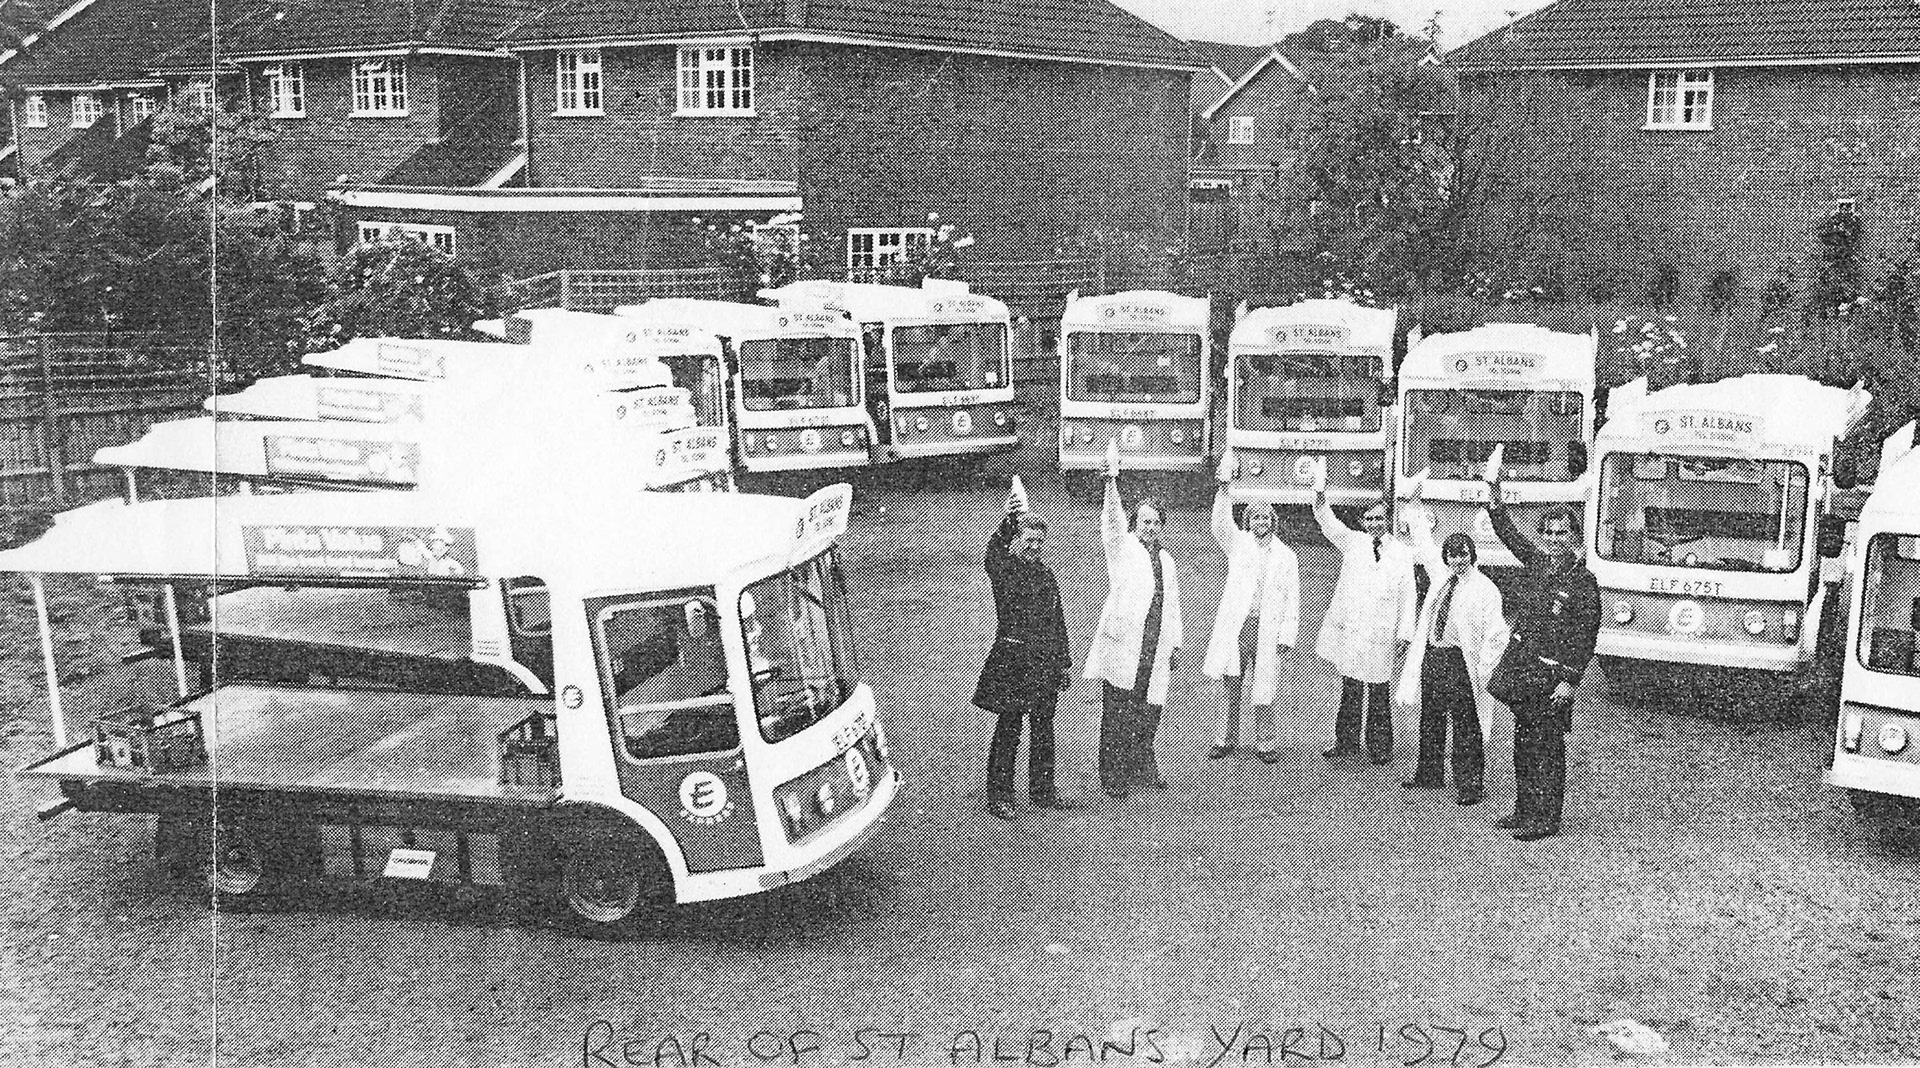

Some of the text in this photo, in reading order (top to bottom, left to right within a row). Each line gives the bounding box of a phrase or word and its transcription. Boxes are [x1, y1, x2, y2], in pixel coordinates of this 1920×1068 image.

[1307, 328, 1342, 339] ALBANS
[1493, 355, 1535, 368] ALBANS
[1701, 417, 1753, 434] ALBANS
[686, 436, 718, 450] ALBANS
[1649, 577, 1723, 596] ELF 675T
